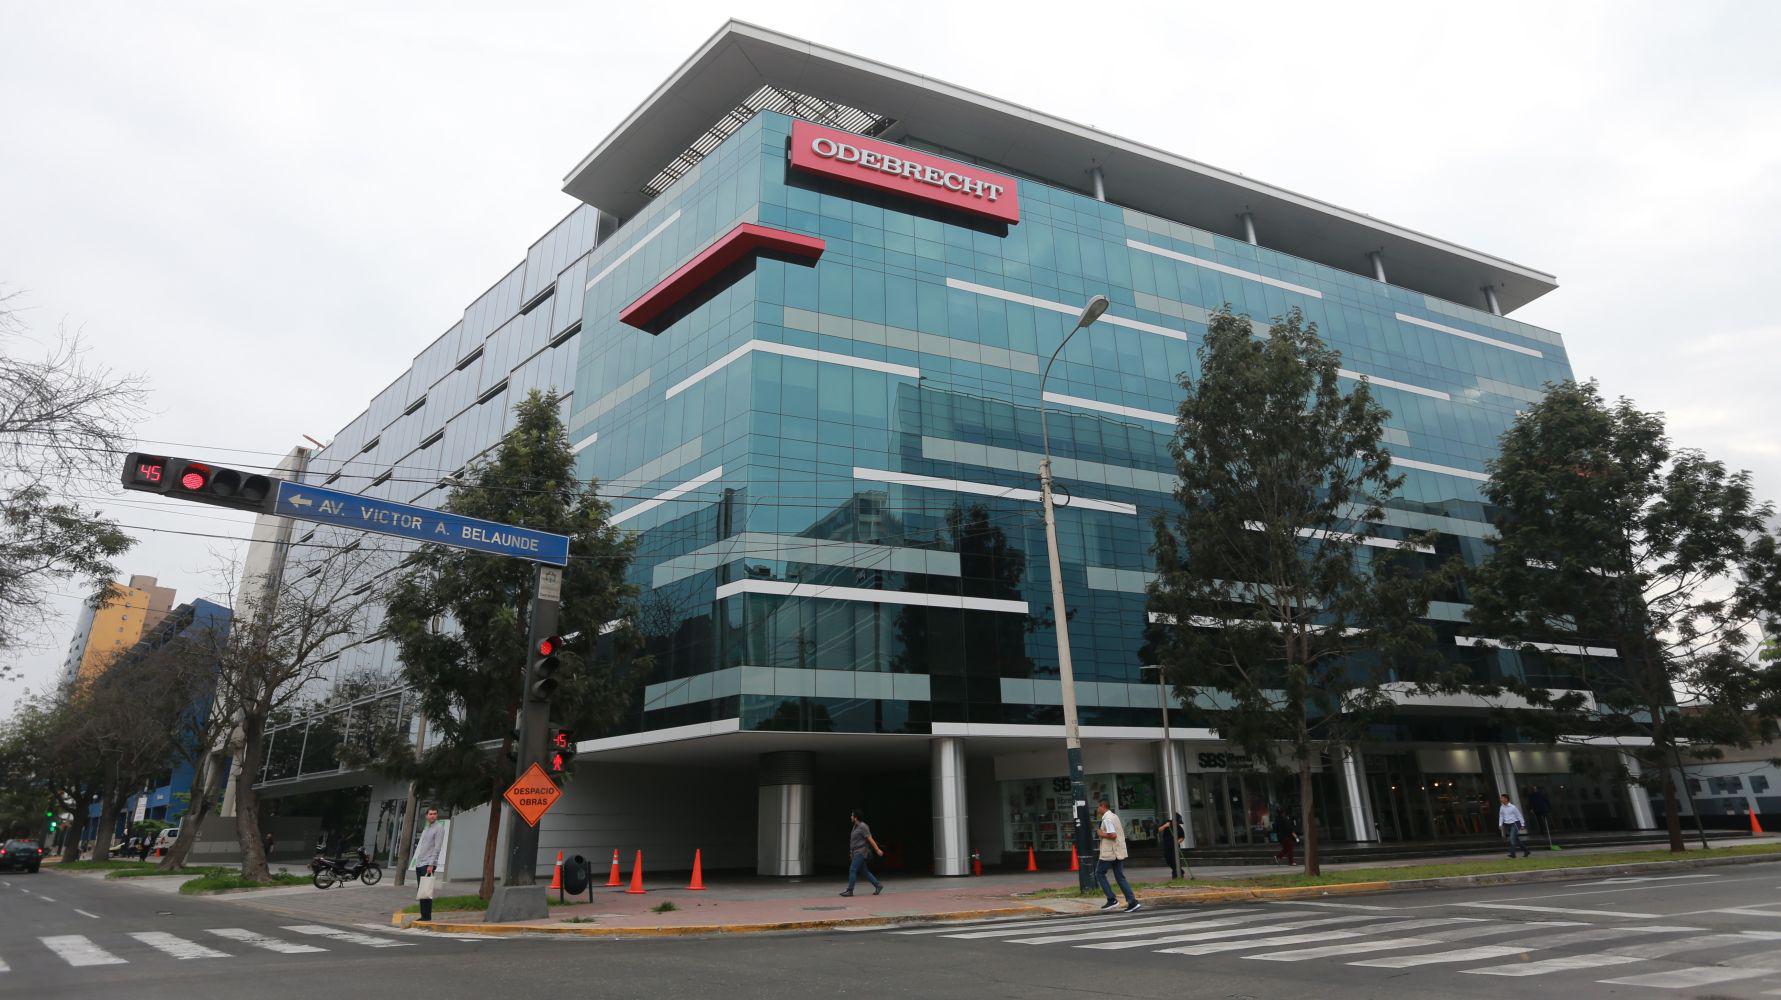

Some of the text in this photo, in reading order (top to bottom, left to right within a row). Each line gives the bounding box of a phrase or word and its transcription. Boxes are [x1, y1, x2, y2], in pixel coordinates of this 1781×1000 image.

[811, 137, 1003, 201] ODEBRECHT
[140, 464, 161, 481] 45
[318, 499, 539, 552] AV. VICTOR A. BELAUNDE
[1198, 752, 1227, 768] SBS
[513, 786, 555, 796] DESPACIO
[519, 797, 548, 806] OBRAS
